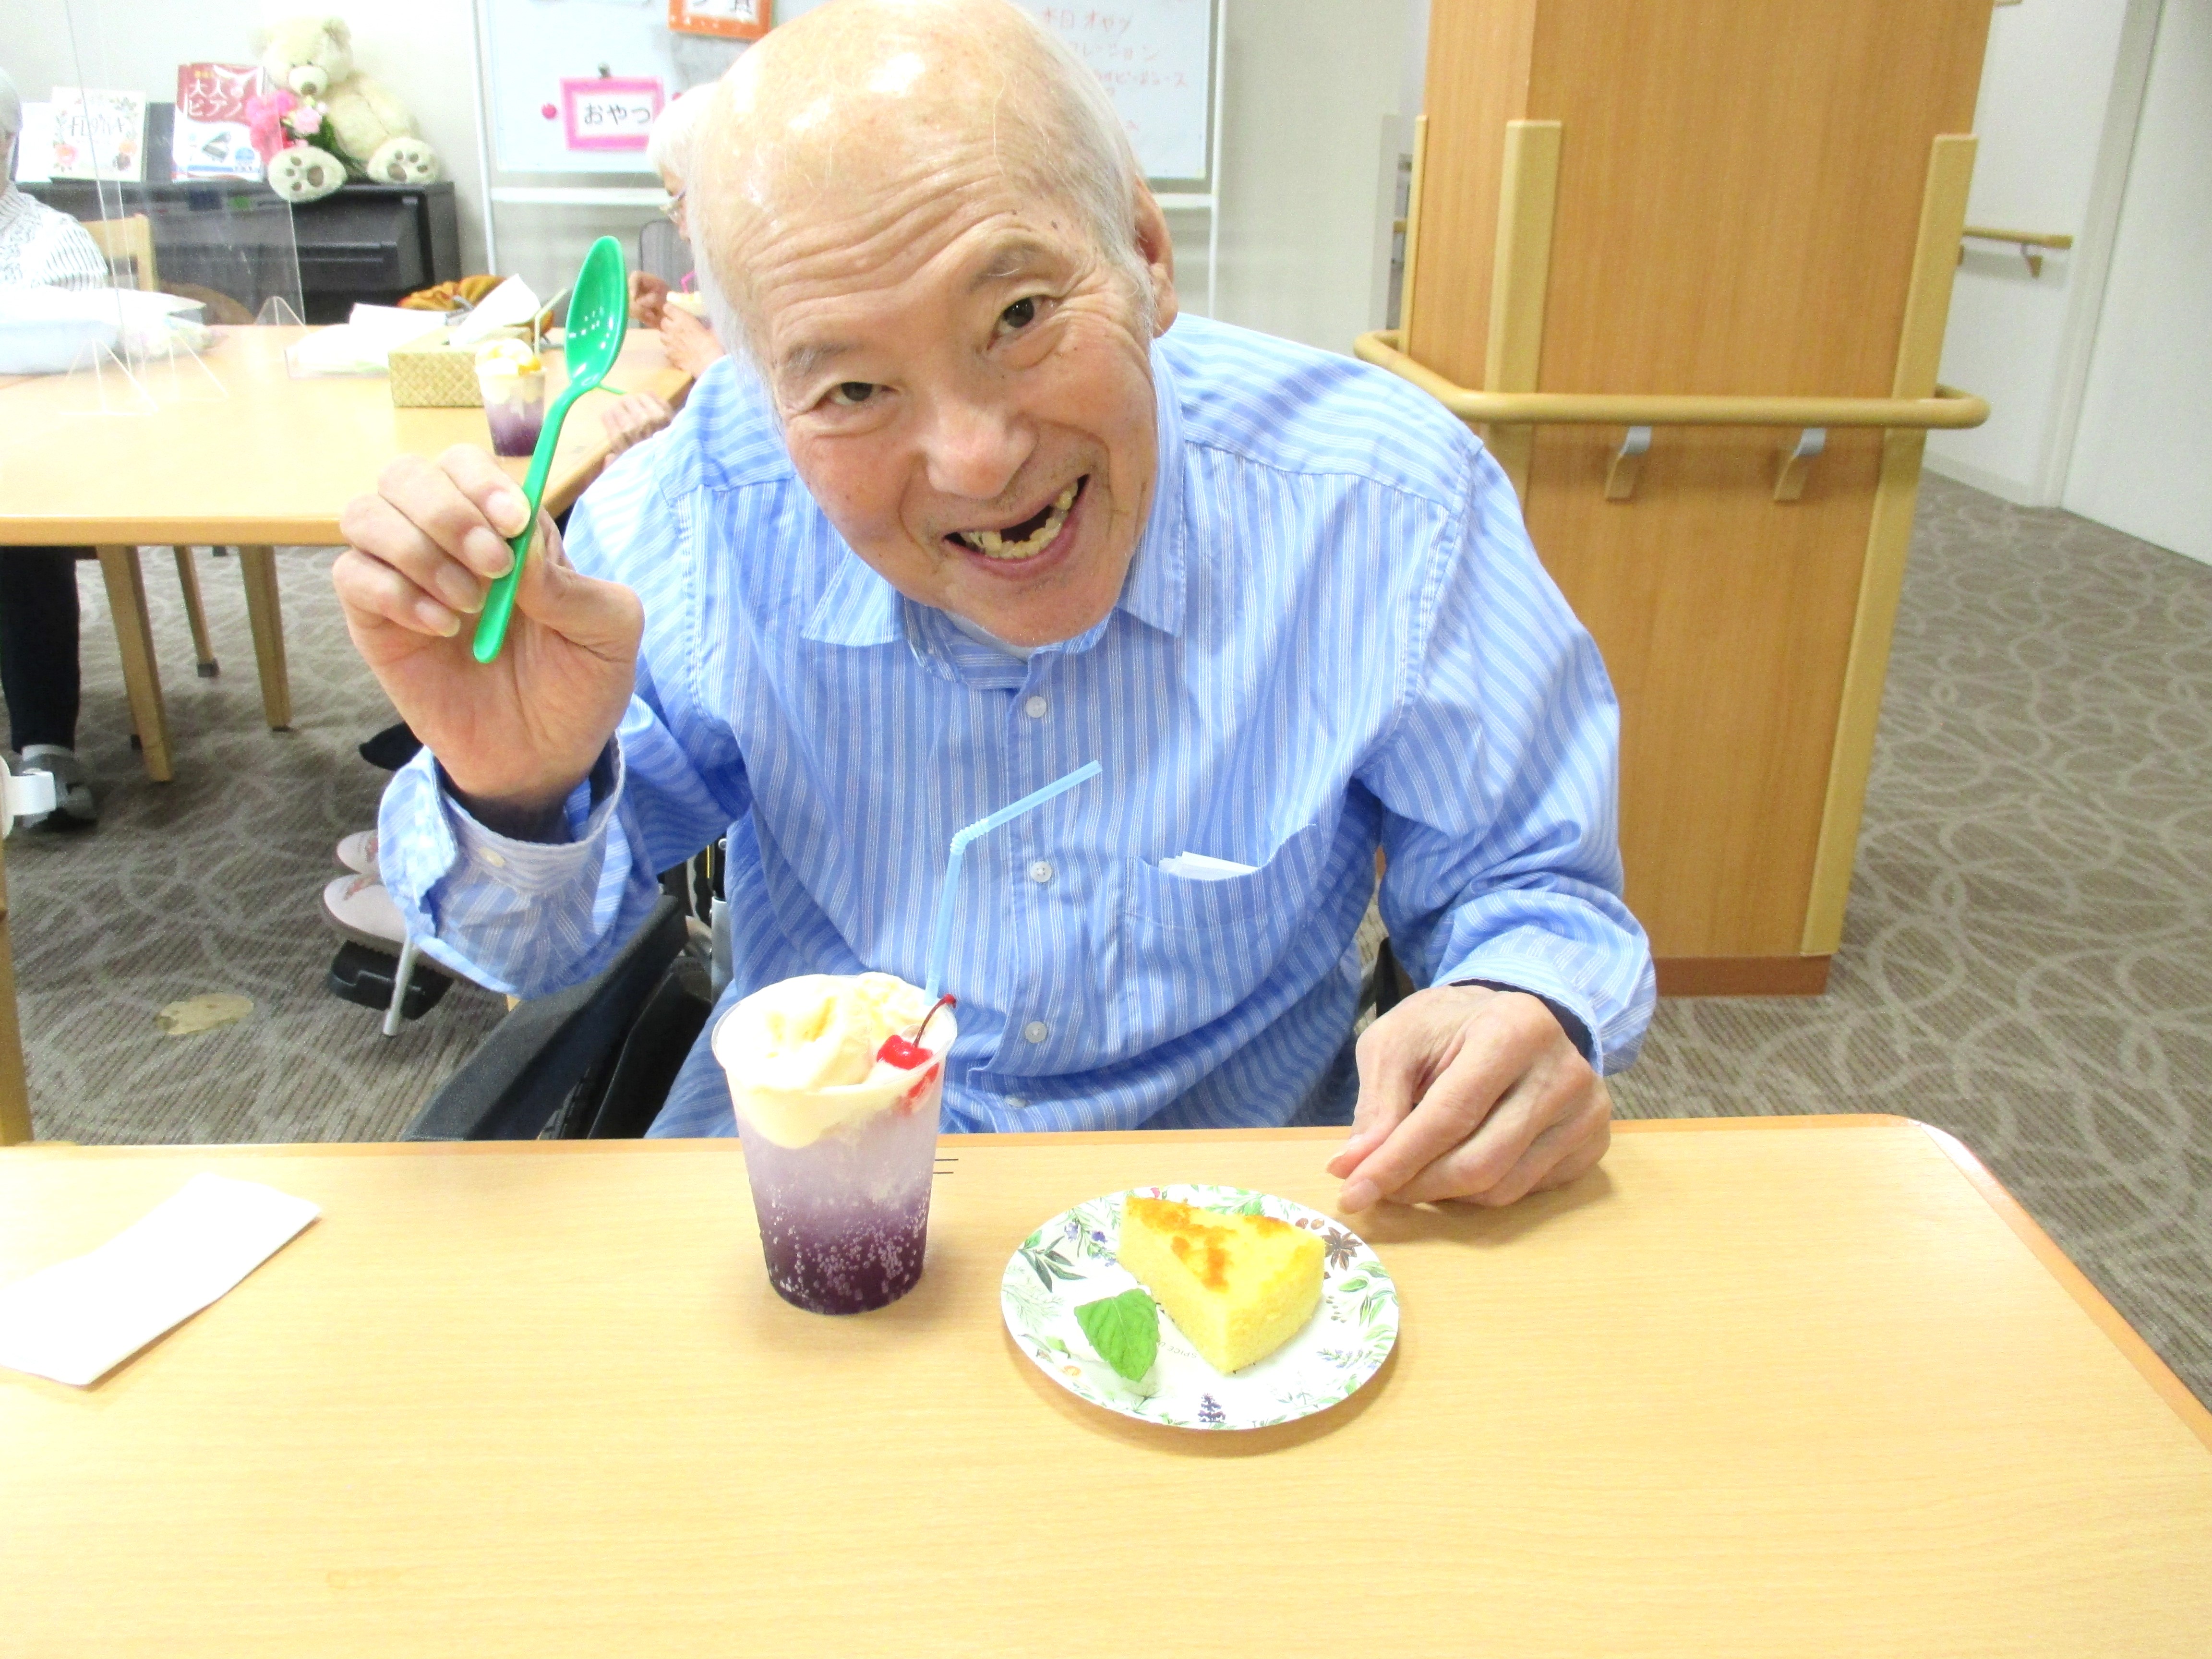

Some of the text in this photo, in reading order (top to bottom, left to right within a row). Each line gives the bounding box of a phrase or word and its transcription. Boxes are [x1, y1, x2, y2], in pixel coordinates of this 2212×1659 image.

[584, 102, 651, 125] おやつ
[1167, 1345, 1197, 1358] SPICE
